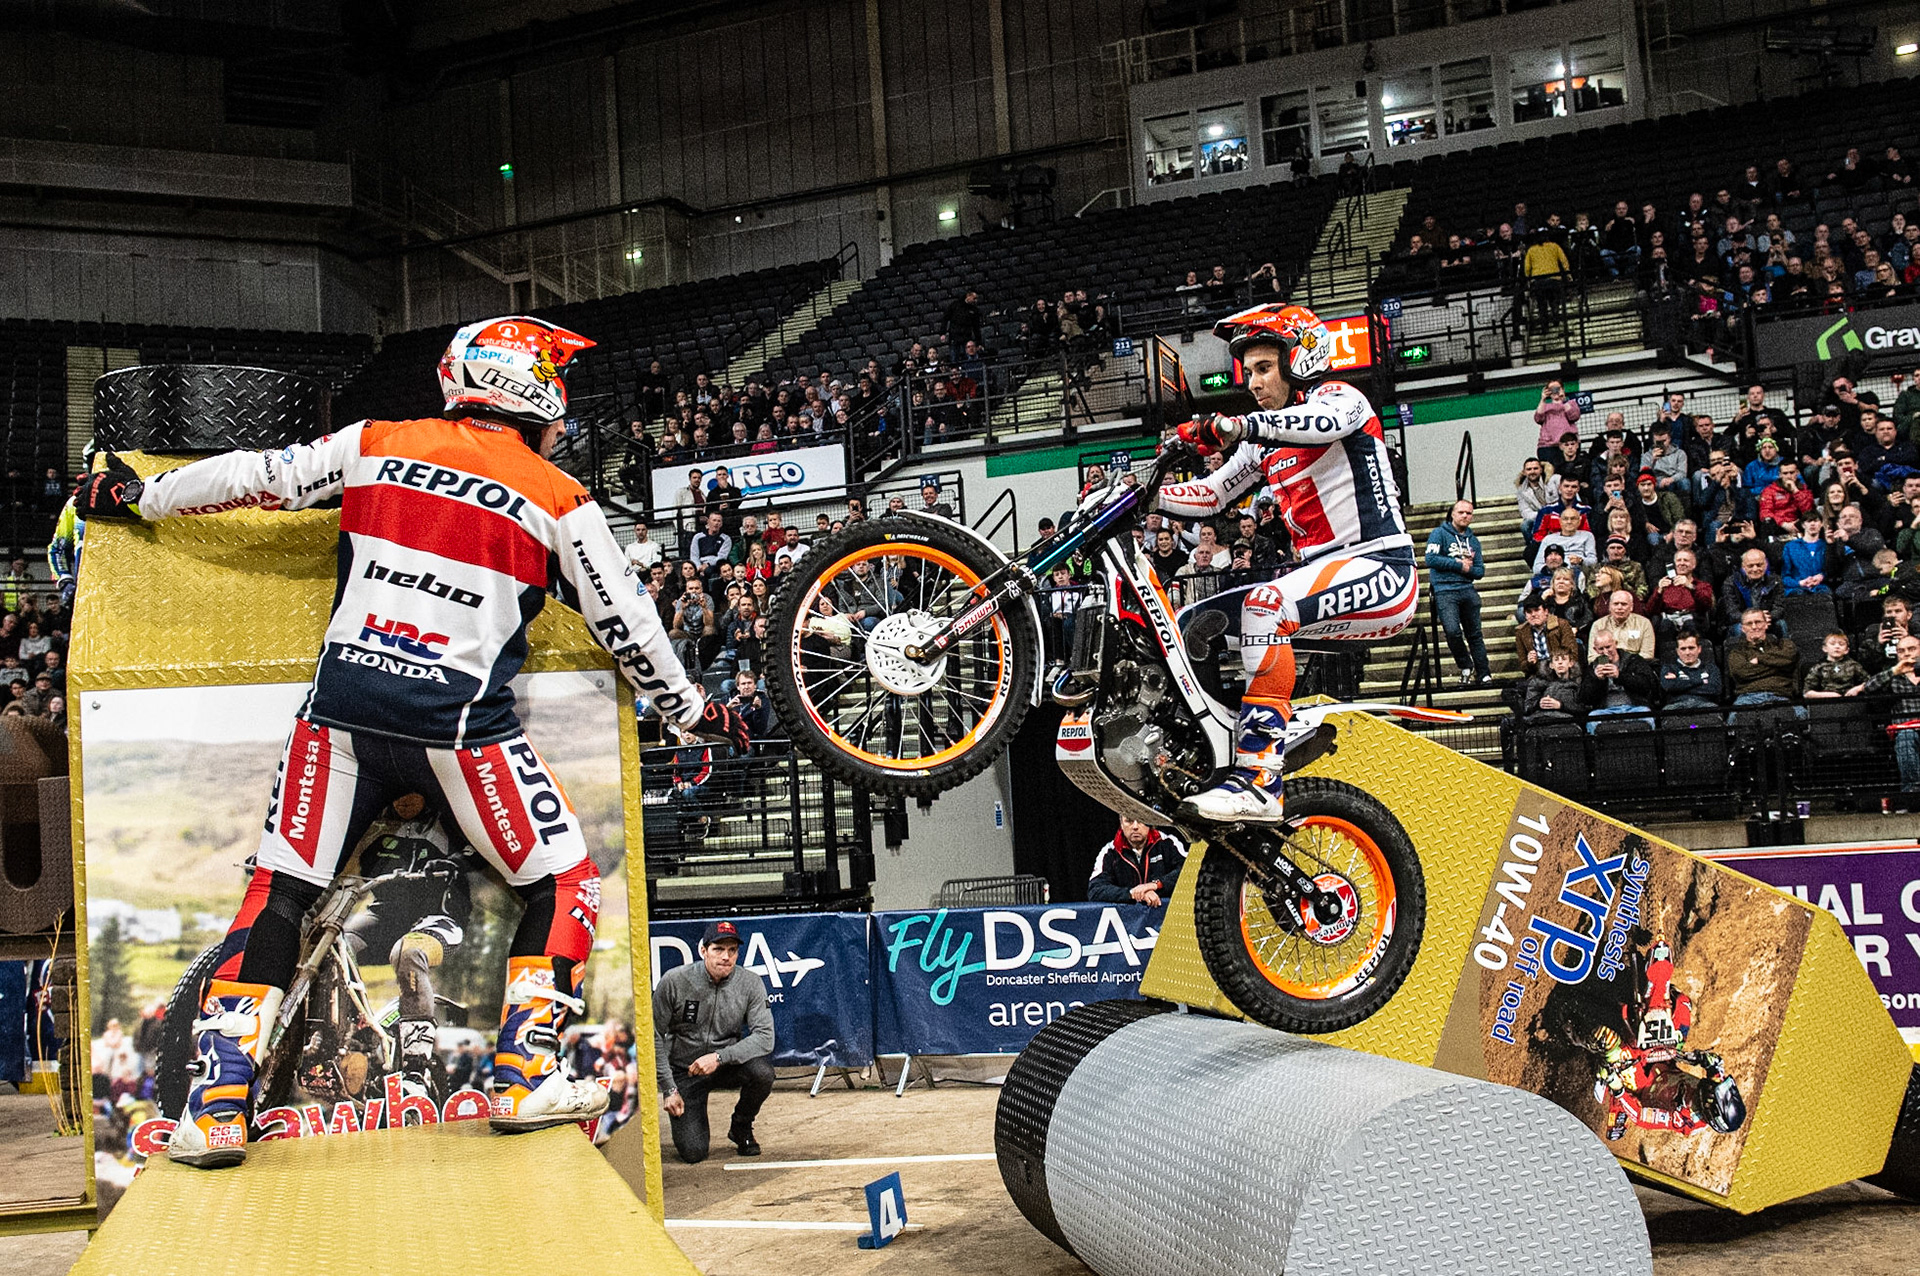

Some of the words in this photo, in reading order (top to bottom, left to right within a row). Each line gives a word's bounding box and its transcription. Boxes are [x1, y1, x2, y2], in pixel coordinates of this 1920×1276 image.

[1383, 303, 1400, 311] 210
[1115, 342, 1130, 350] 211
[480, 367, 560, 418] hebo
[1577, 395, 1591, 406] 09
[296, 468, 344, 497] heb
[1111, 456, 1128, 464] 110
[1267, 455, 1298, 477] hebo
[177, 490, 281, 516] HONDA
[376, 459, 527, 521] REPSOL
[1364, 454, 1389, 519] HONDA
[363, 560, 485, 609] hebo
[572, 540, 613, 607] hebo
[1317, 564, 1405, 620] REPSOL
[358, 613, 450, 660] HRC
[1137, 585, 1176, 653] REPSOL
[1242, 632, 1292, 648] hebo
[337, 647, 450, 685] HONDA
[999, 637, 1013, 699] REPSOL
[1061, 726, 1087, 738] REPSOL
[288, 740, 320, 840] Montesa
[476, 761, 523, 854] Montesa
[1473, 813, 1551, 972] 10W-40
[1527, 830, 1629, 986] xrp
[1596, 856, 1651, 983] synthesis
[650, 932, 784, 992] DA
[887, 907, 980, 1006] Fly
[982, 906, 1142, 971] DSA
[986, 973, 1045, 987] Doncaster
[1047, 972, 1099, 985] Sheffield
[1101, 970, 1142, 985] Airport
[1354, 933, 1391, 984] REPSOL
[1512, 936, 1541, 981] off
[1490, 980, 1526, 1044] road
[880, 1188, 904, 1240] 4
